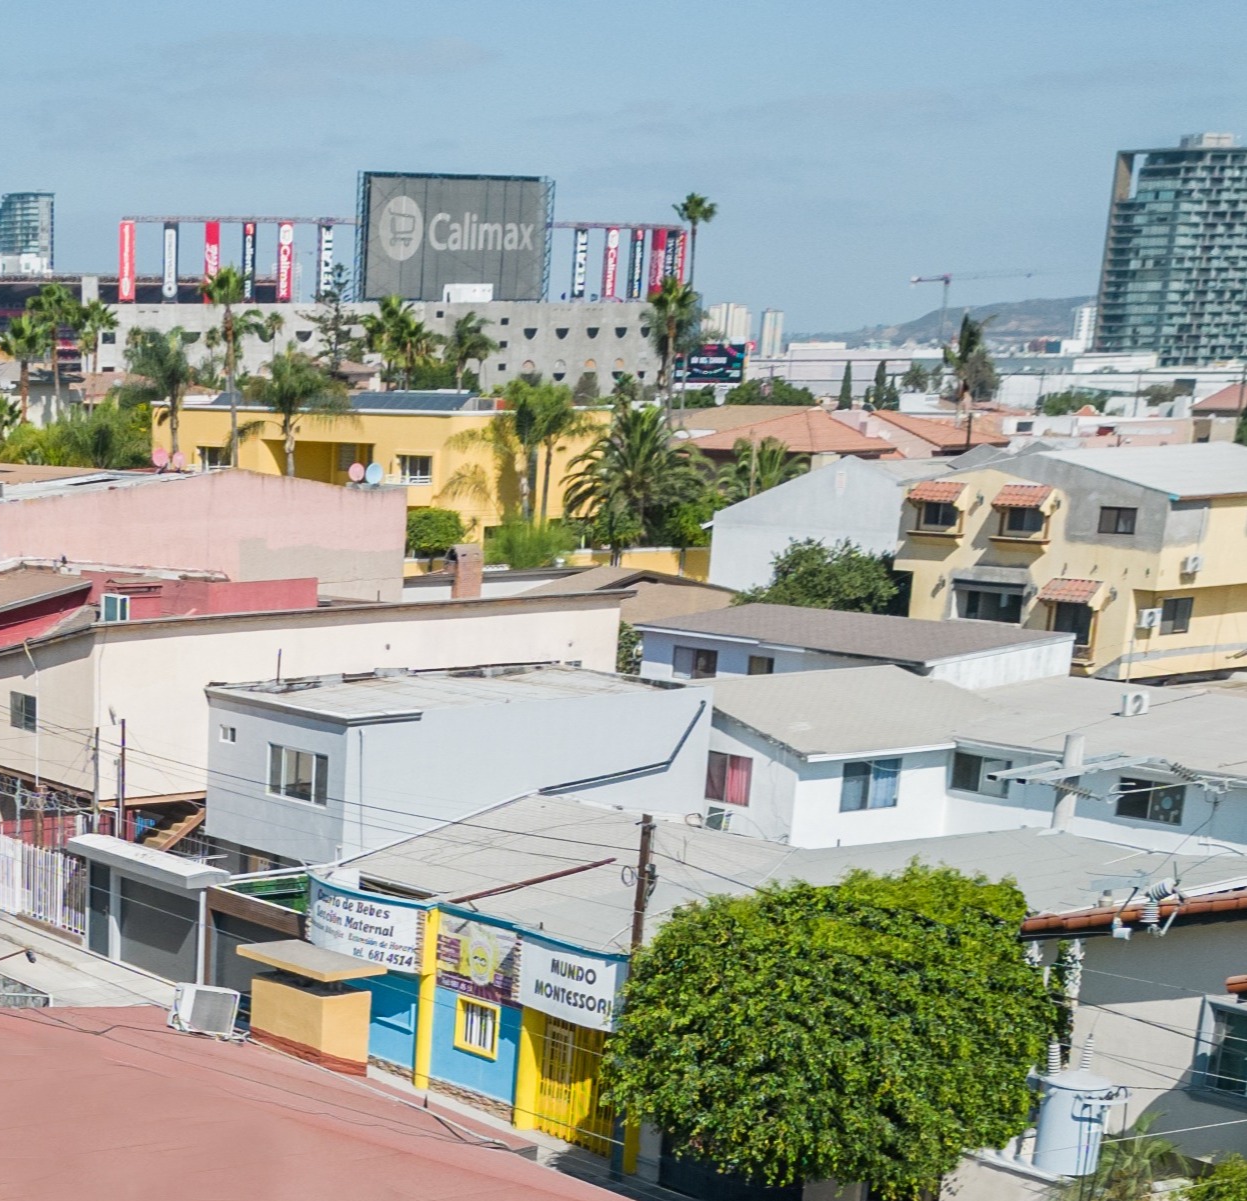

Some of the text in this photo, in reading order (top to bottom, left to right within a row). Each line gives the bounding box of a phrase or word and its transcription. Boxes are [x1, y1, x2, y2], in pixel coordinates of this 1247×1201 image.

[429, 212, 535, 251] Calimax
[279, 245, 291, 298] Calimax
[319, 226, 333, 296] TECATE
[574, 229, 588, 296] TECATE
[605, 248, 617, 296] Calimax
[342, 899, 354, 912] de
[345, 915, 394, 937] Maternal
[368, 948, 384, 964] 681
[386, 952, 413, 968] 4514
[551, 958, 597, 985] MUNDO
[534, 979, 612, 1017] MONTESSORI
